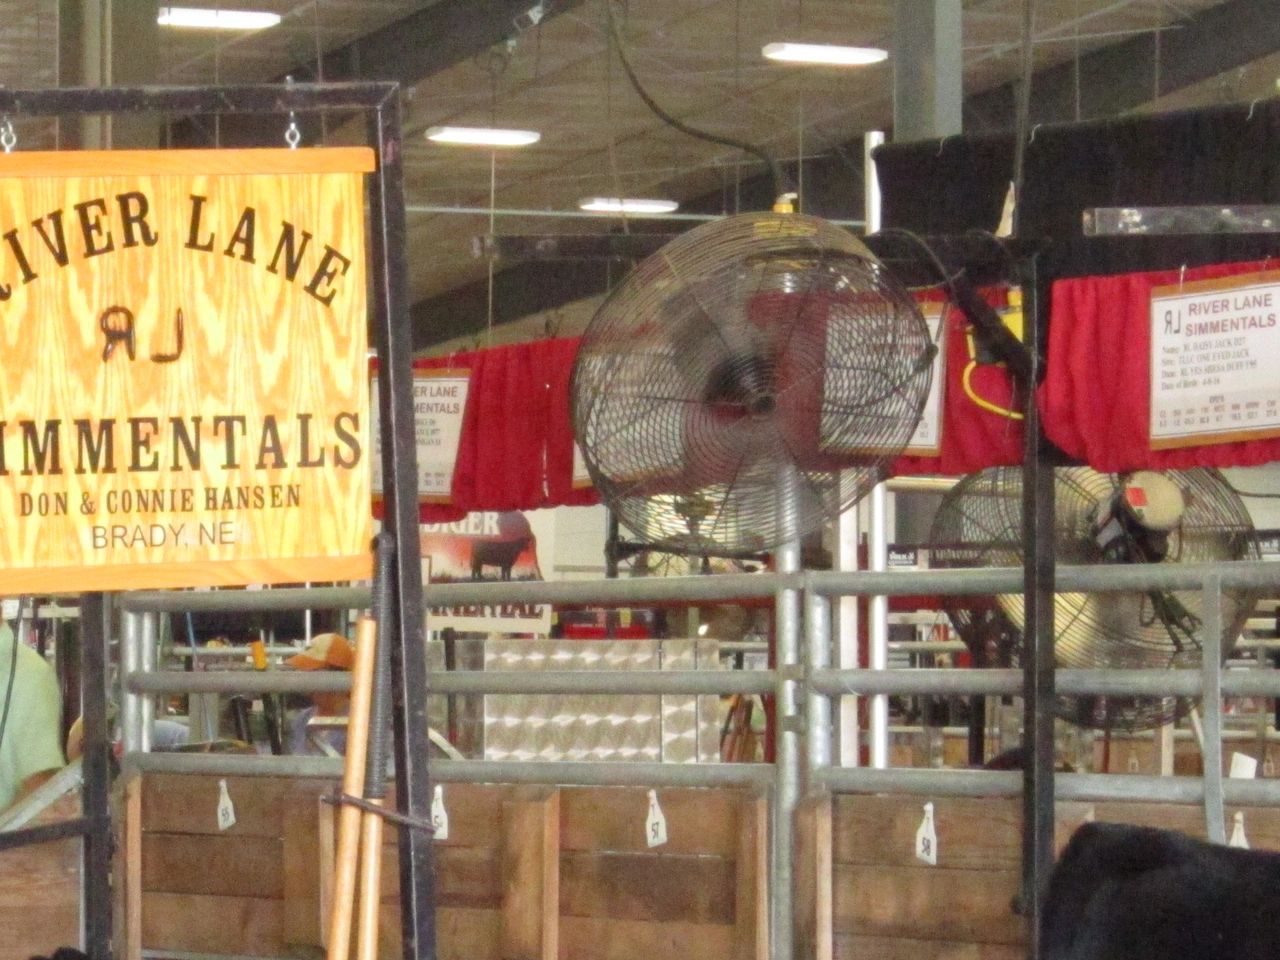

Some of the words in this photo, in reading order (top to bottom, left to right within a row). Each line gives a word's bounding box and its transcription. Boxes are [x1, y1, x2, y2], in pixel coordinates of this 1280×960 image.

[183, 193, 351, 307] LANE
[1188, 299, 1230, 316] RIVER
[1234, 294, 1273, 311] LANE
[1185, 313, 1276, 337] SIMMENTALS
[430, 386, 458, 397] LANE
[20, 491, 69, 517] DON
[80, 491, 96, 516] &
[106, 488, 194, 514] CONNIE
[204, 484, 301, 510] HANSEN
[198, 521, 235, 545] NE
